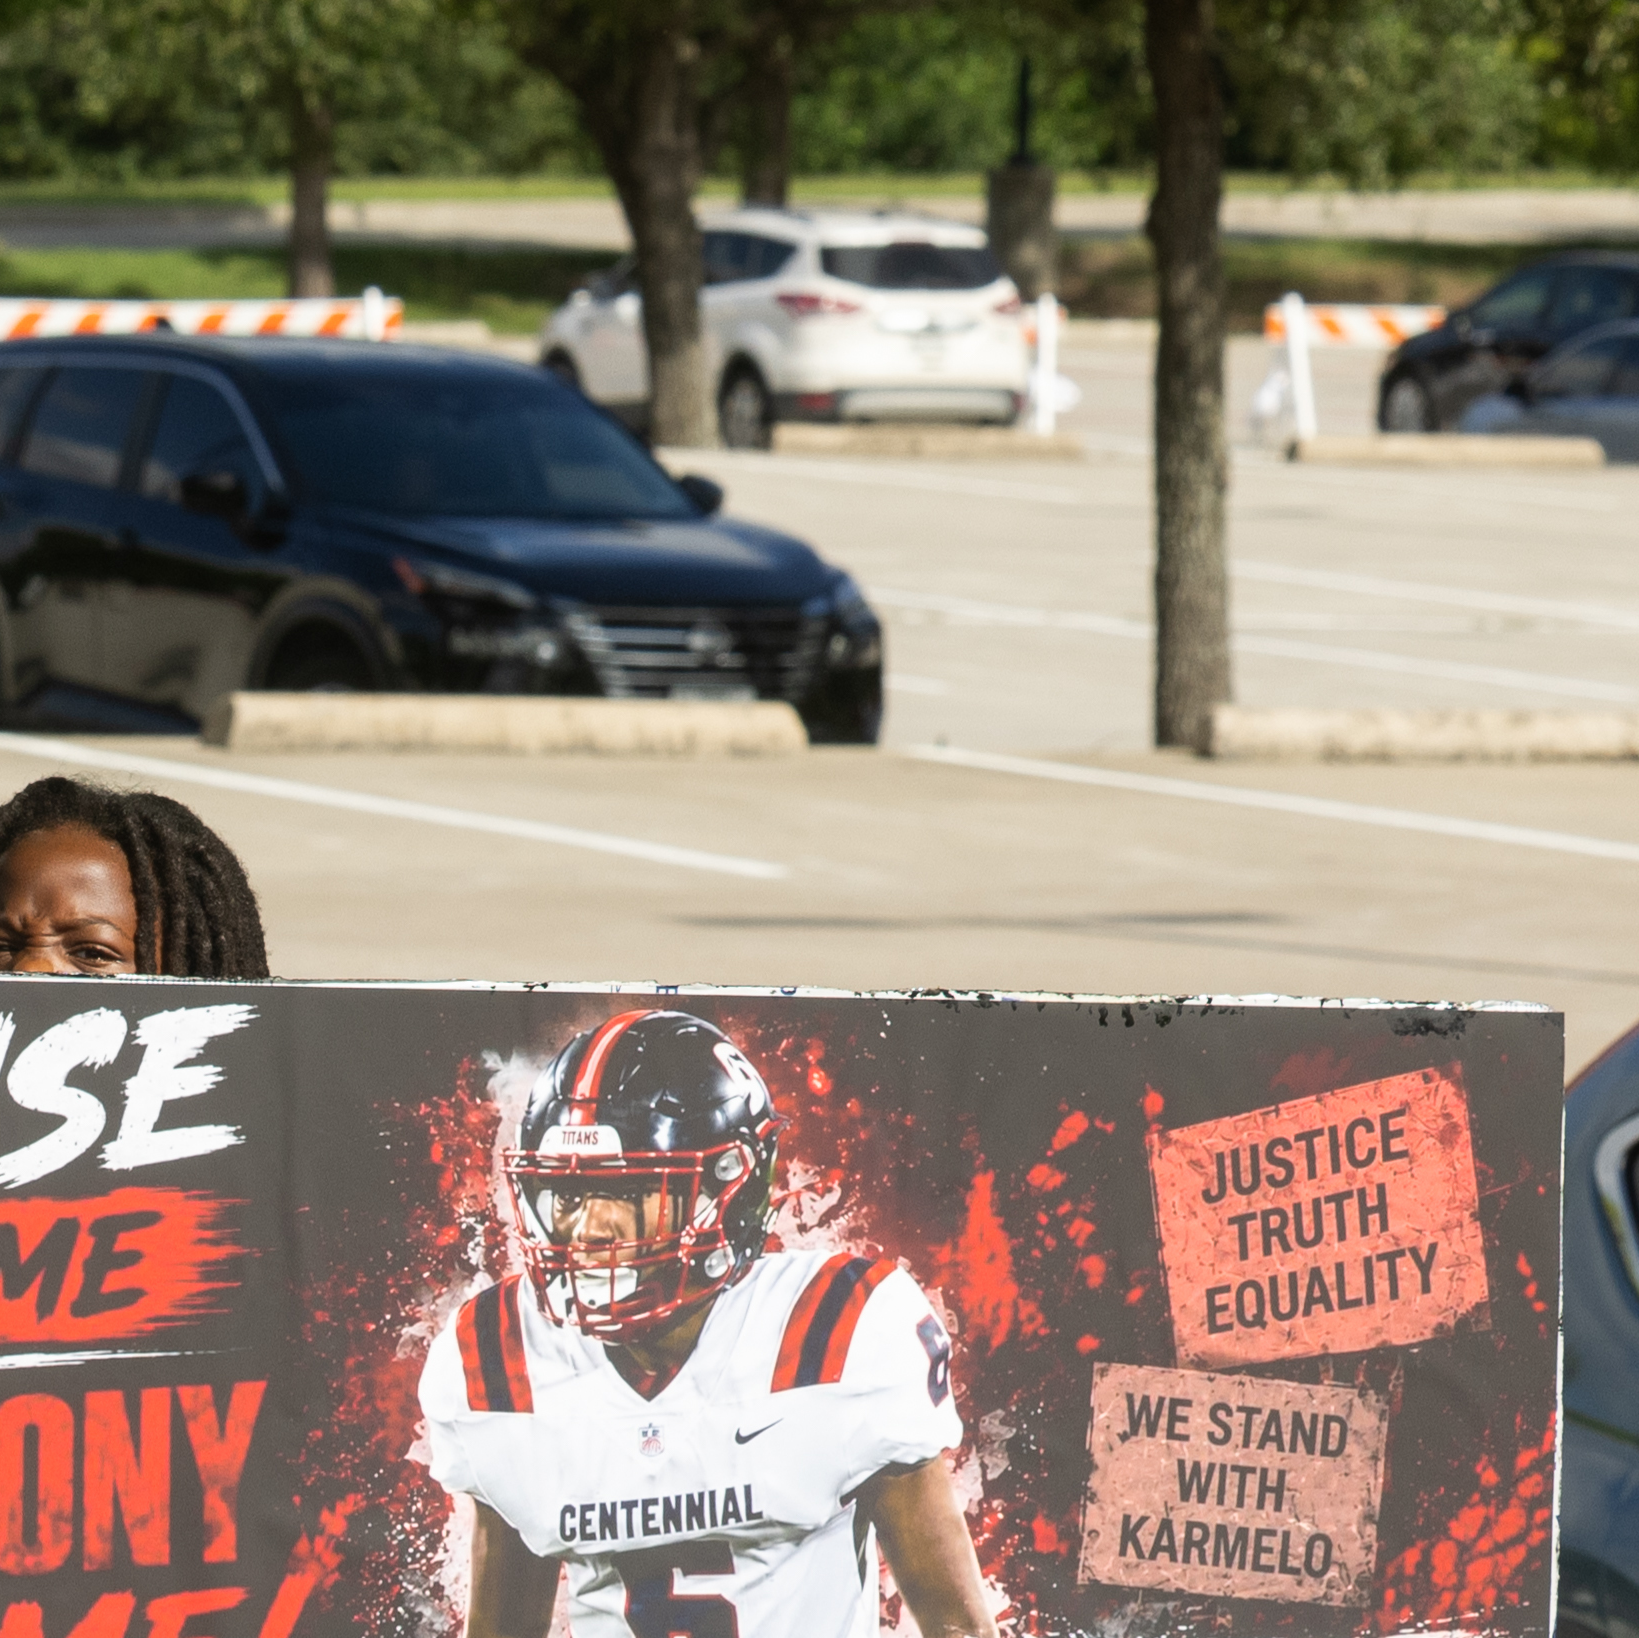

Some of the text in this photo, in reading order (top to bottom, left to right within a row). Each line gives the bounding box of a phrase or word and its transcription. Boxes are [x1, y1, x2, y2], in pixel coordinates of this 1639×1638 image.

[562, 1131, 598, 1145] TITANS
[1201, 1107, 1409, 1204] JUSTICE
[1228, 1182, 1389, 1262] TRUTH
[1207, 1243, 1438, 1335] EQUALITY
[1125, 1392, 1348, 1458] WE STAND
[559, 1484, 763, 1542] CENTENNIAL
[1177, 1458, 1286, 1513] WITH
[1118, 1514, 1333, 1579] KARMELO
